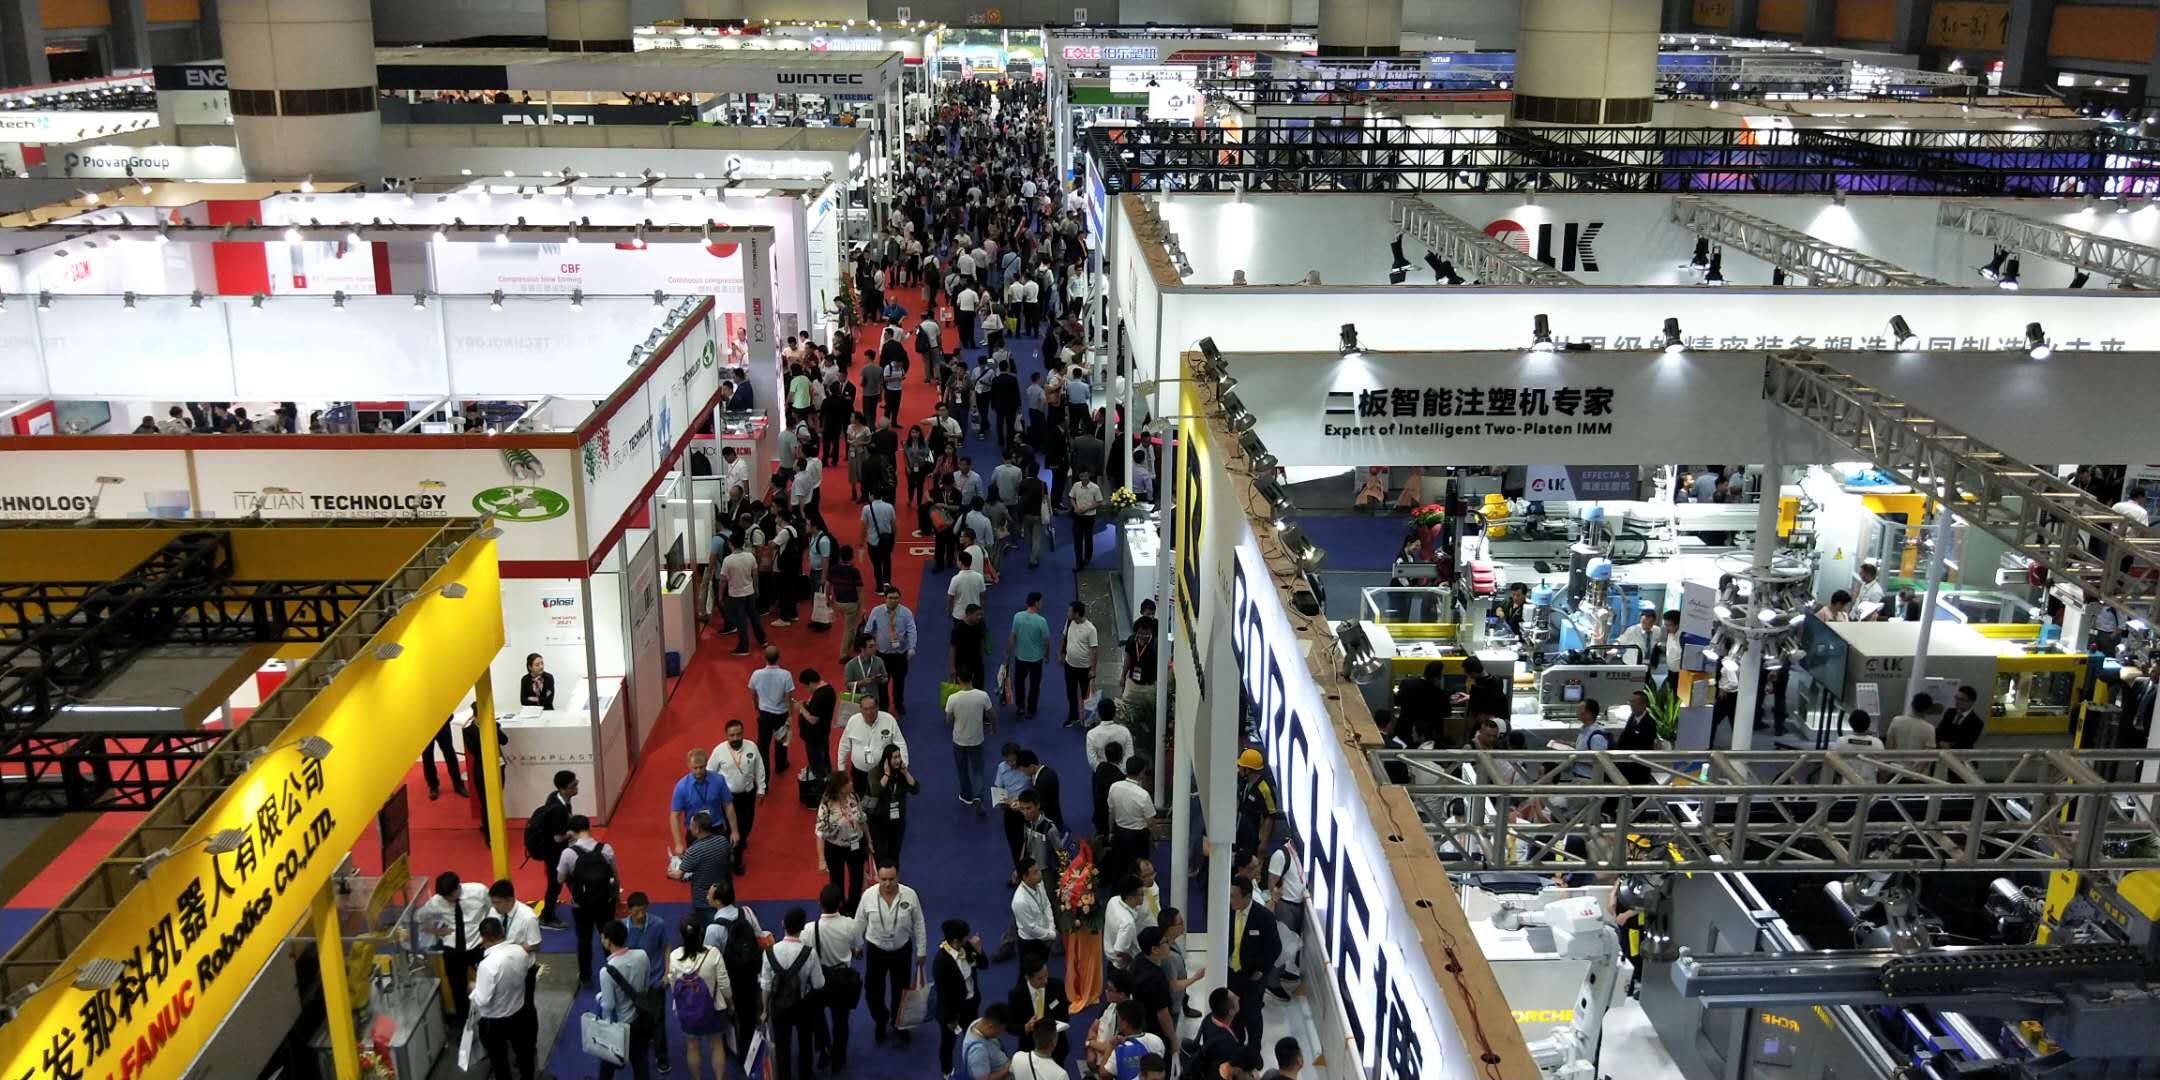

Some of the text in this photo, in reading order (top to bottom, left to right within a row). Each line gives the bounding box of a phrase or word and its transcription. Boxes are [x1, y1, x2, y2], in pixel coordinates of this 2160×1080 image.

[777, 73, 863, 84] WINTEC
[1537, 222, 1604, 272] LK
[561, 264, 581, 274] CBF
[1325, 387, 1614, 418] 二板智能注塑机专家
[1324, 422, 1613, 439] Expert of Intelligent Two-Platen IMM
[1582, 470, 1632, 480] EFFECTA-S
[0, 496, 98, 511] HNOLOGY
[233, 494, 446, 511] ITALIAN TECHNOLOGY
[14, 756, 324, 1080] 发那科机器人有限公司
[196, 887, 273, 992] Robotics
